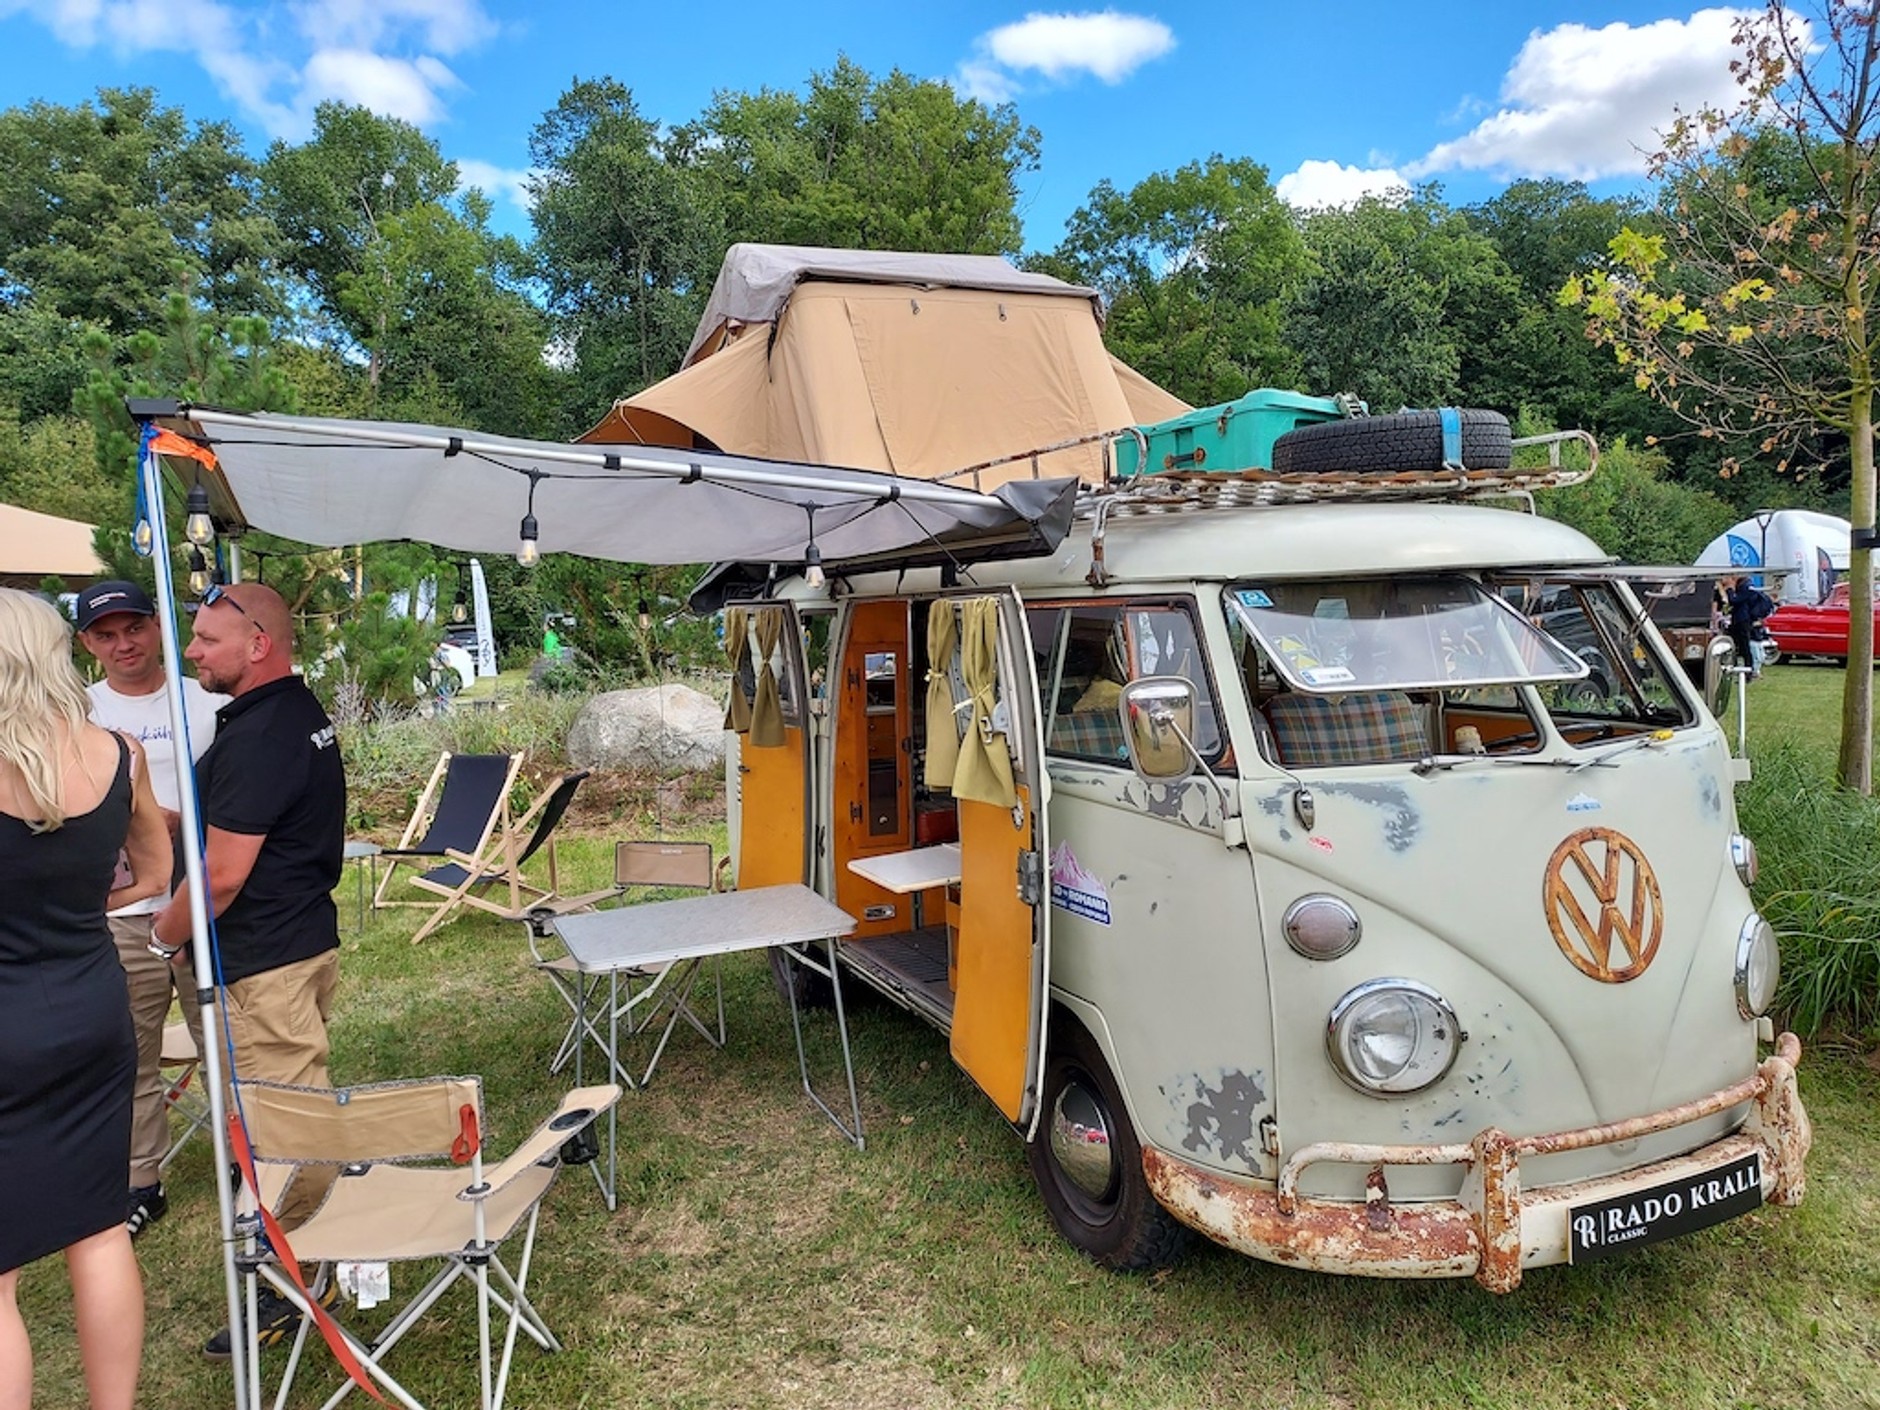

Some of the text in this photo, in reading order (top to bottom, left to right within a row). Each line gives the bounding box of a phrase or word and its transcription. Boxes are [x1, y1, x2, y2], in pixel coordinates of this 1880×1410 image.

[1607, 1165, 1760, 1232] RADO KRALL
[1607, 1227, 1648, 1245] CLASSIC
